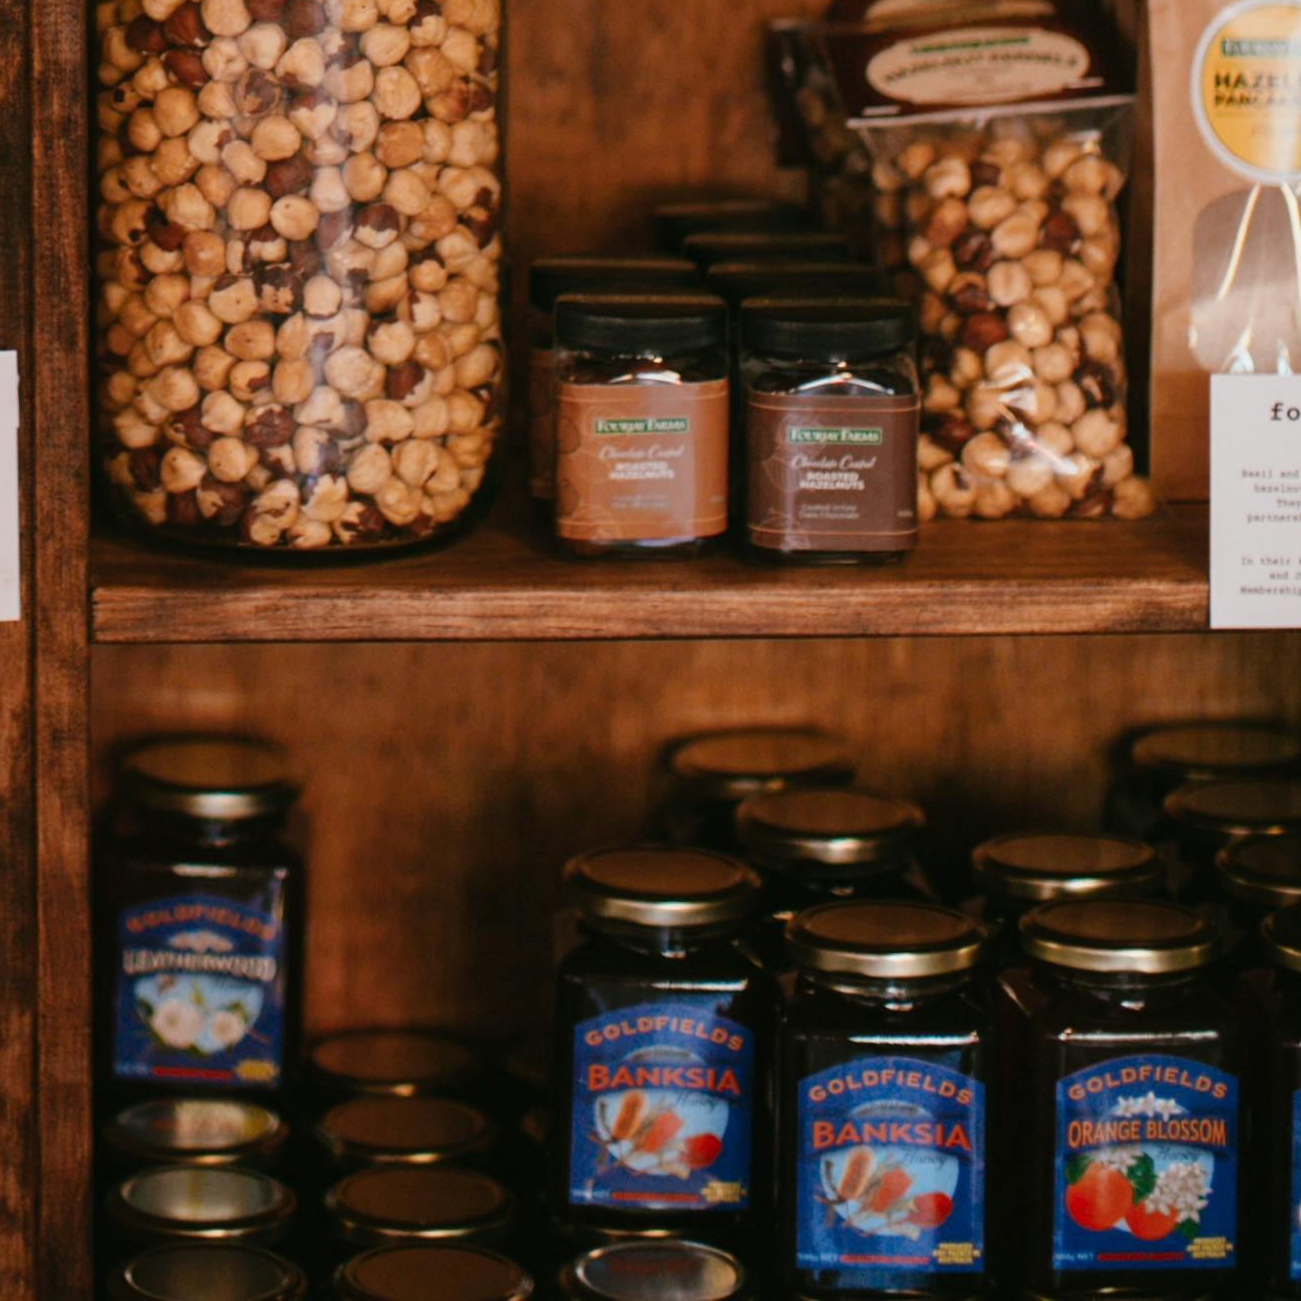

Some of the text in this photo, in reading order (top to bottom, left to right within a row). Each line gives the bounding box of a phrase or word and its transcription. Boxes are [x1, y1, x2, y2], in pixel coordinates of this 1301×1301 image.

[585, 1016, 744, 1051] GOLDFIELDS
[587, 1064, 740, 1094] BANKSIA
[809, 1069, 972, 1104] GOLDFIELDS
[1068, 1066, 1227, 1100] GOLDFIELDS
[813, 1121, 972, 1152] BANKSIA
[1068, 1120, 1227, 1148] ORANGE BLOSSOM
